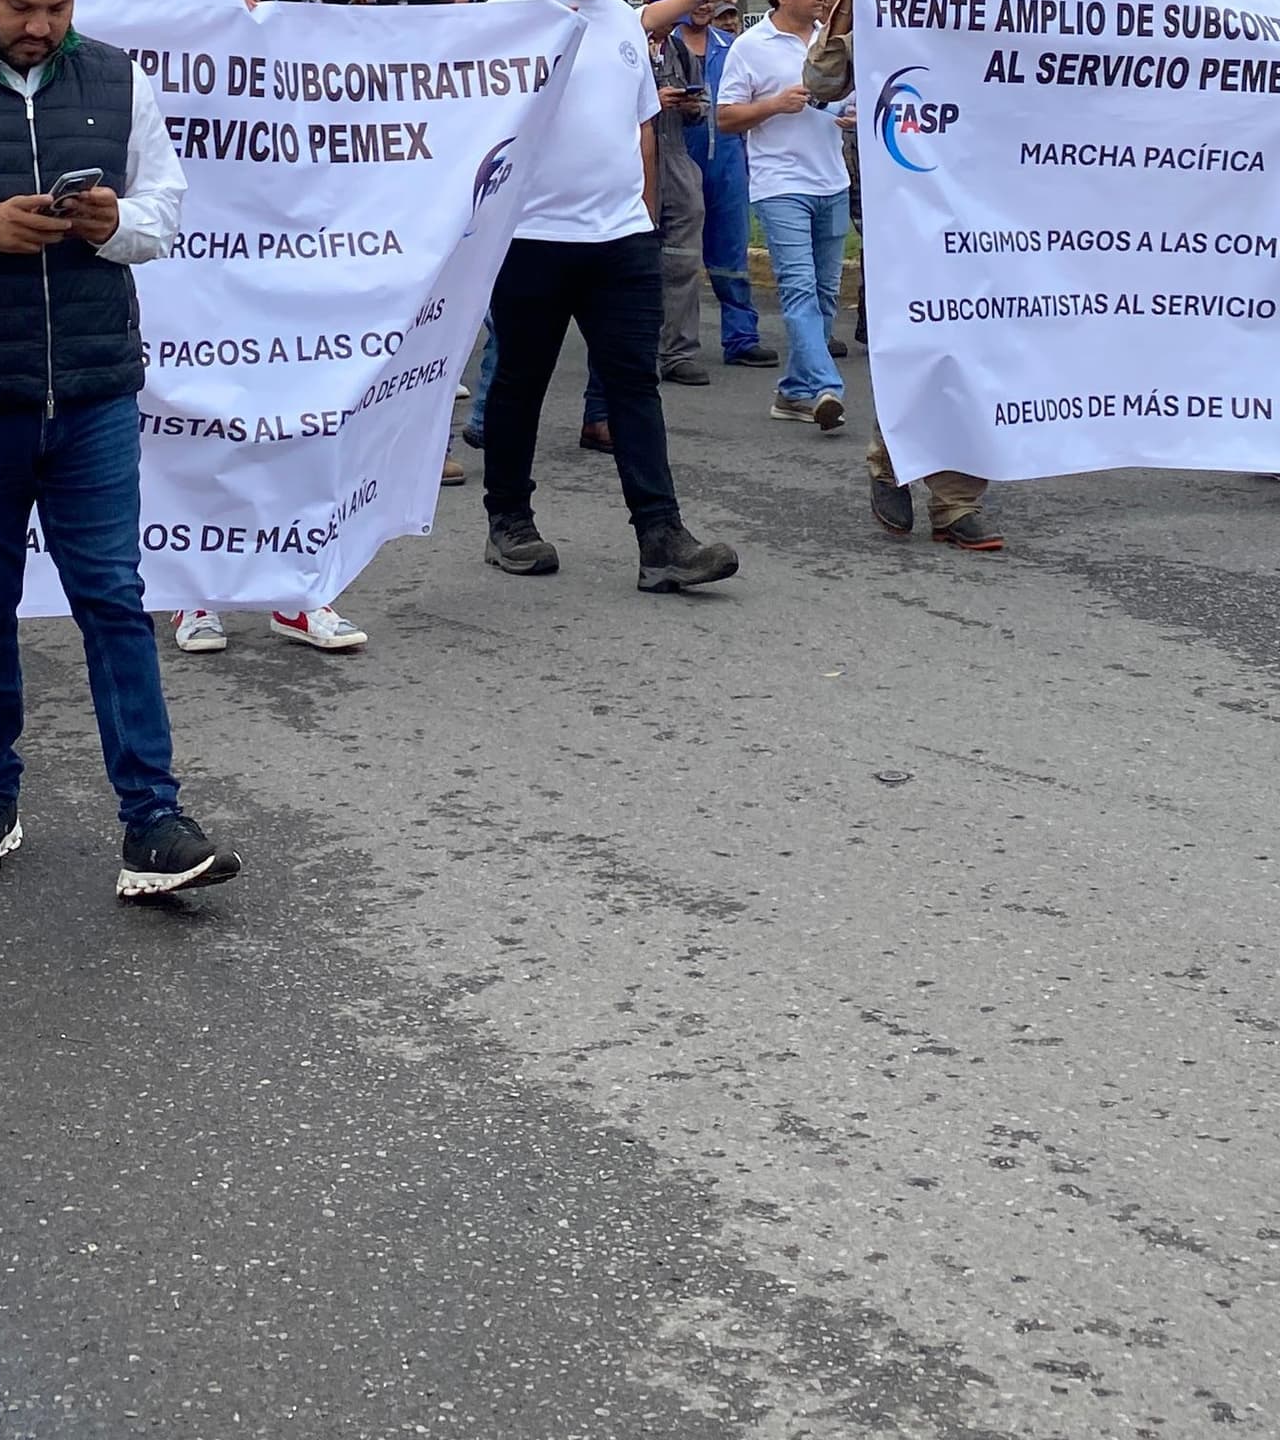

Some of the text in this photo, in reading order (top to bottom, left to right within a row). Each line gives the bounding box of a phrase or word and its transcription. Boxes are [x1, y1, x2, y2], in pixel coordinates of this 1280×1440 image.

[1117, 2, 1154, 38] DE
[121, 48, 216, 96] PLIO
[227, 55, 267, 98] DE
[983, 49, 1025, 84] AL
[1035, 51, 1190, 90] SERVICIO
[887, 102, 960, 135] FASP
[164, 116, 434, 164] ERVICIO PEMEX
[1020, 142, 1265, 173] MARCHA PACÍFICA
[166, 226, 404, 260] RCHA PACÍFICA
[944, 230, 1041, 254] EXIGIMOS
[1047, 229, 1131, 253] PAGOS
[1136, 231, 1153, 252] A
[1160, 231, 1208, 254] LAS
[908, 292, 1109, 324] SUBCONTRATISTAS
[1114, 293, 1145, 316] AL
[1151, 294, 1277, 319] SERVICIO
[159, 338, 261, 368] PAGOS
[268, 336, 289, 364] A
[296, 334, 353, 362] LAS
[139, 412, 248, 443] TISTAS
[254, 415, 294, 444] AL
[375, 375, 399, 404] DE
[995, 396, 1084, 427] ADEUDOS
[1088, 395, 1117, 418] DE
[1123, 389, 1179, 418] MÁS
[1187, 396, 1224, 419] DE
[1231, 397, 1272, 420] UN
[200, 525, 247, 554] DE
[255, 519, 326, 555] MÁS
